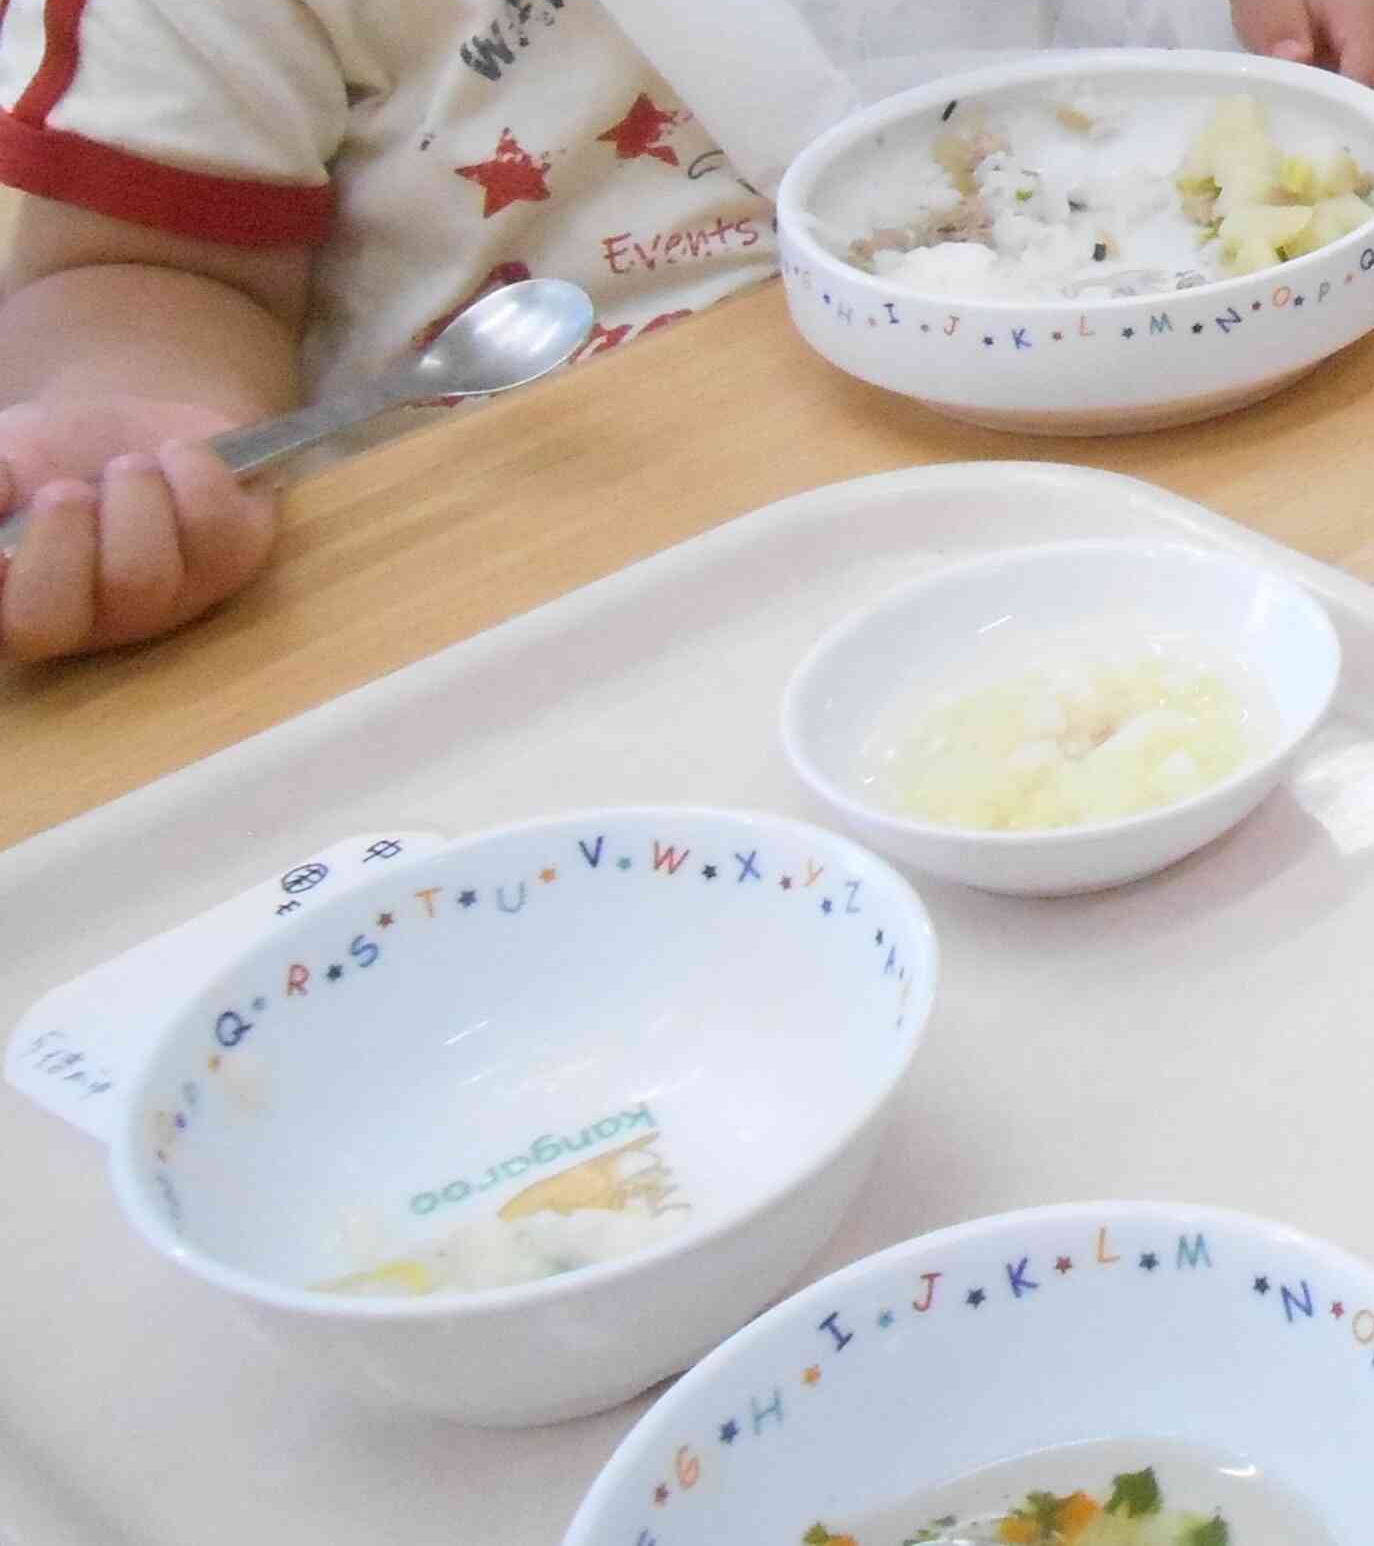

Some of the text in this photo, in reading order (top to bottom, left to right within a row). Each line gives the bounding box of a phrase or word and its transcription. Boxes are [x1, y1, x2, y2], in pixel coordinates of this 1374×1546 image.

[602, 217, 759, 274] Events
[837, 303, 853, 325] H
[883, 303, 899, 324] I
[943, 315, 960, 336] J
[1012, 328, 1031, 349] K
[1077, 315, 1095, 337] L
[1150, 312, 1173, 334] M
[1215, 307, 1242, 333] N
[1273, 287, 1291, 307] O
[1318, 281, 1331, 303] P
[216, 1011, 253, 1047] Q
[287, 964, 310, 995] R
[349, 935, 379, 968] S
[414, 887, 443, 918] T
[496, 882, 528, 914] U
[579, 836, 603, 868] V
[653, 841, 690, 875] W
[735, 850, 760, 882] X
[804, 860, 824, 887] Y
[845, 880, 861, 914] Z
[410, 1101, 657, 1216] kangaroo
[675, 1445, 700, 1490] G
[751, 1390, 784, 1435] H
[819, 1312, 853, 1351] I
[912, 1272, 942, 1312] J
[1006, 1257, 1038, 1298] K
[1096, 1227, 1120, 1264] L
[1177, 1233, 1211, 1268] M
[1280, 1281, 1313, 1322] N
